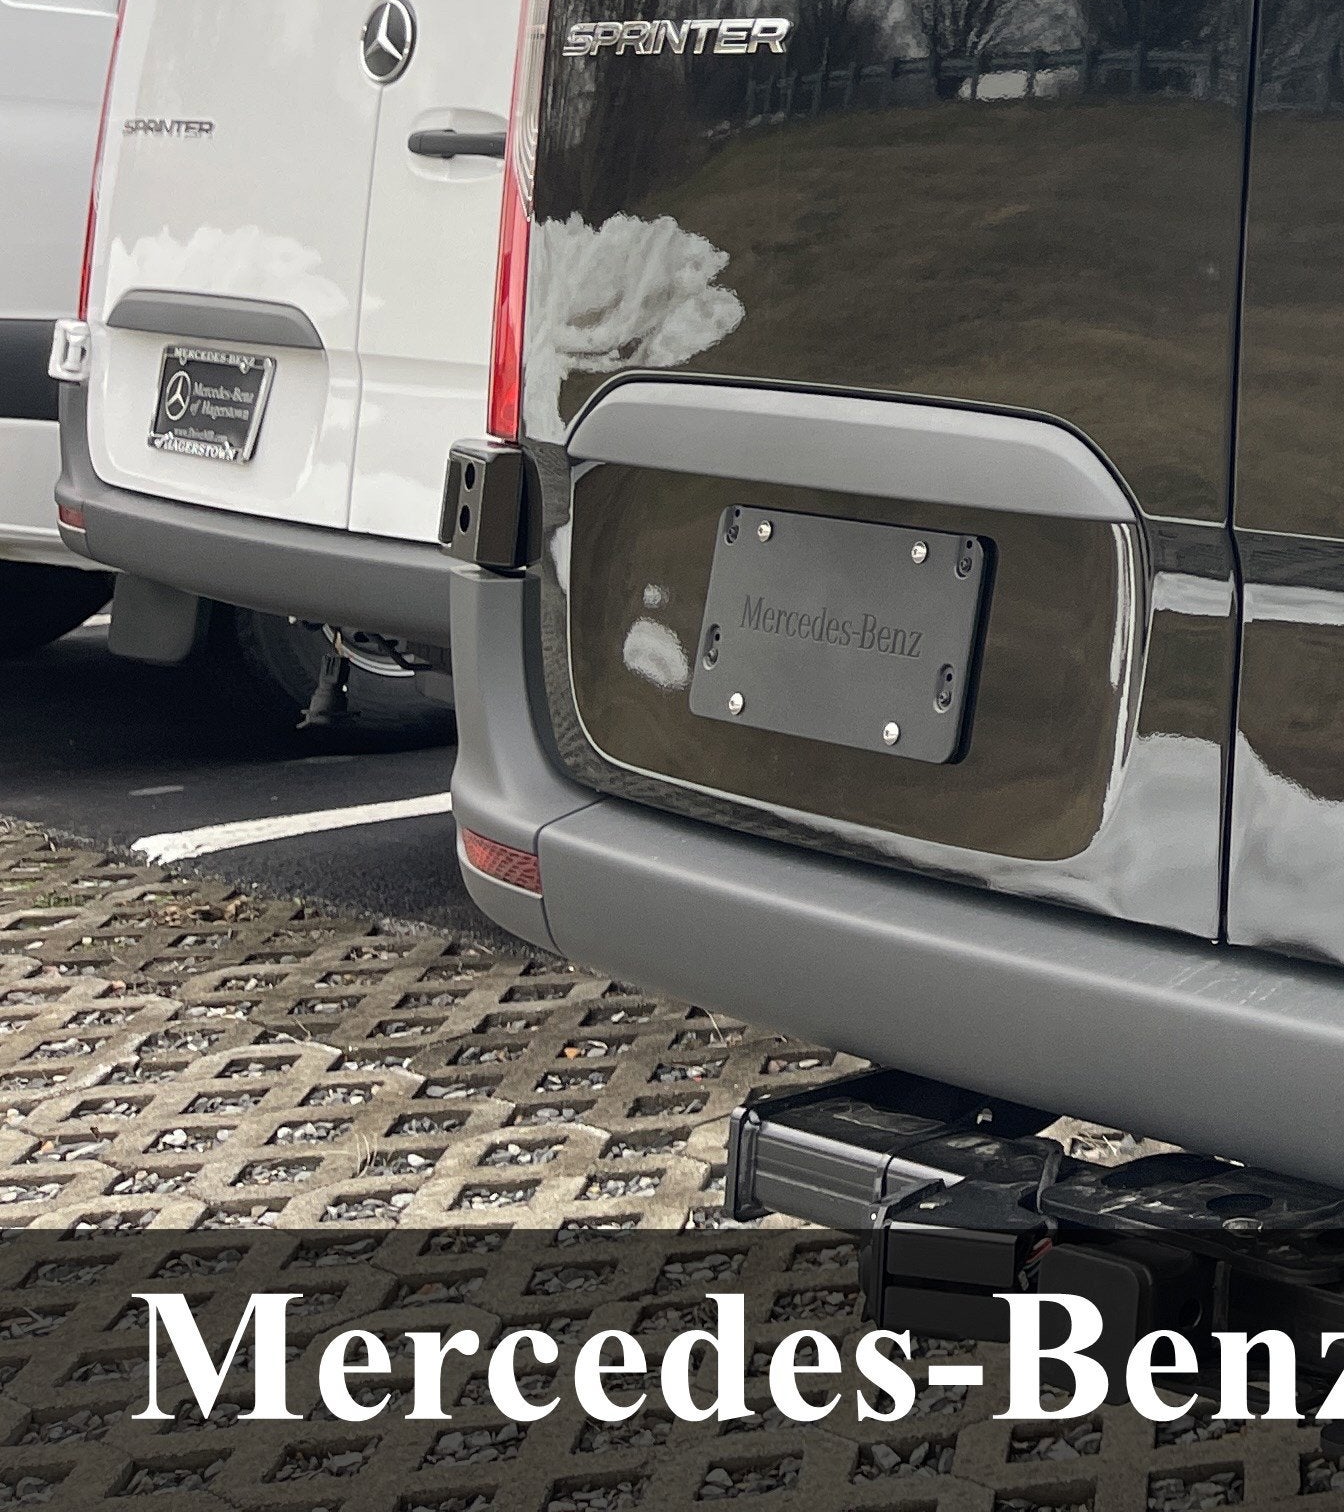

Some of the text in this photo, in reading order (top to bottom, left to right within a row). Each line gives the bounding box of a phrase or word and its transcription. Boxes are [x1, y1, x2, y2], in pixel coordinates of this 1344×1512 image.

[562, 17, 792, 57] SPRINTER
[122, 118, 215, 139] SPRINTER
[193, 381, 255, 404] Mercedes-Benz
[740, 594, 924, 659] Mercedes-Benz
